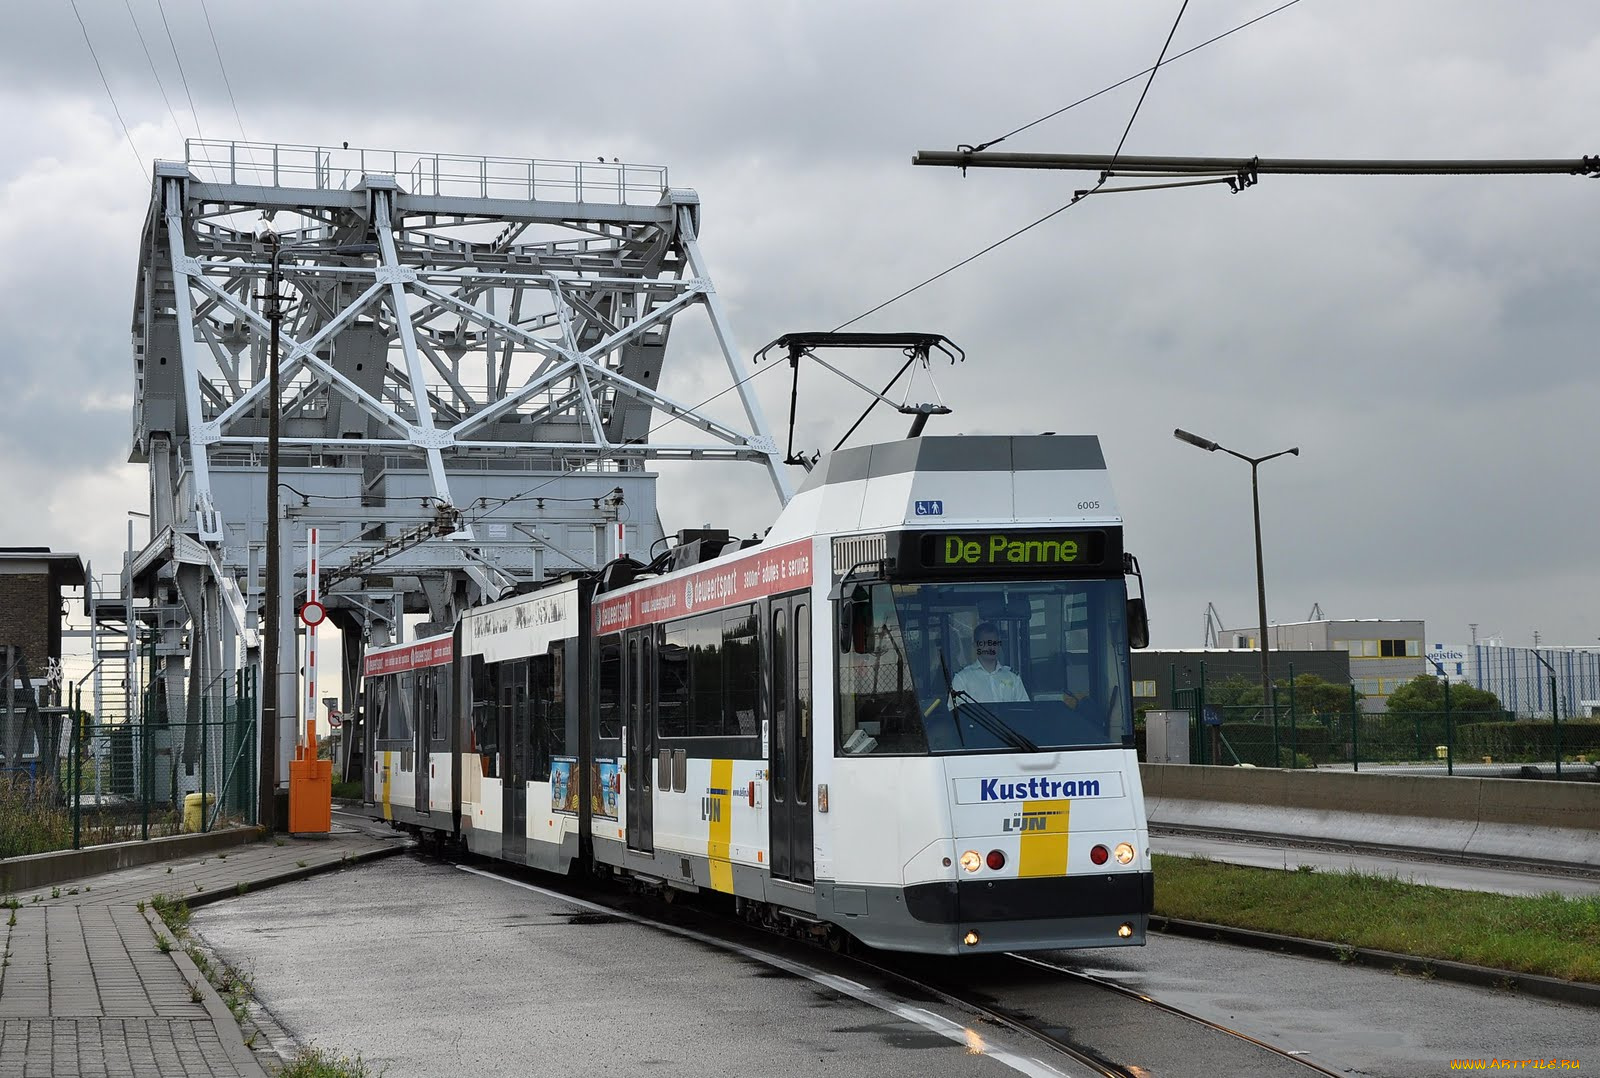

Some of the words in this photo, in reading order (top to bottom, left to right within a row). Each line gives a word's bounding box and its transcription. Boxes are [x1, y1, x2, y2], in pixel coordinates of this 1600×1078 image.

[1077, 501, 1100, 510] 6005
[945, 535, 981, 563] De
[988, 535, 1078, 562] Panne
[695, 567, 737, 605] deweertsport
[781, 559, 786, 579] &
[980, 777, 1099, 801] Kusttram
